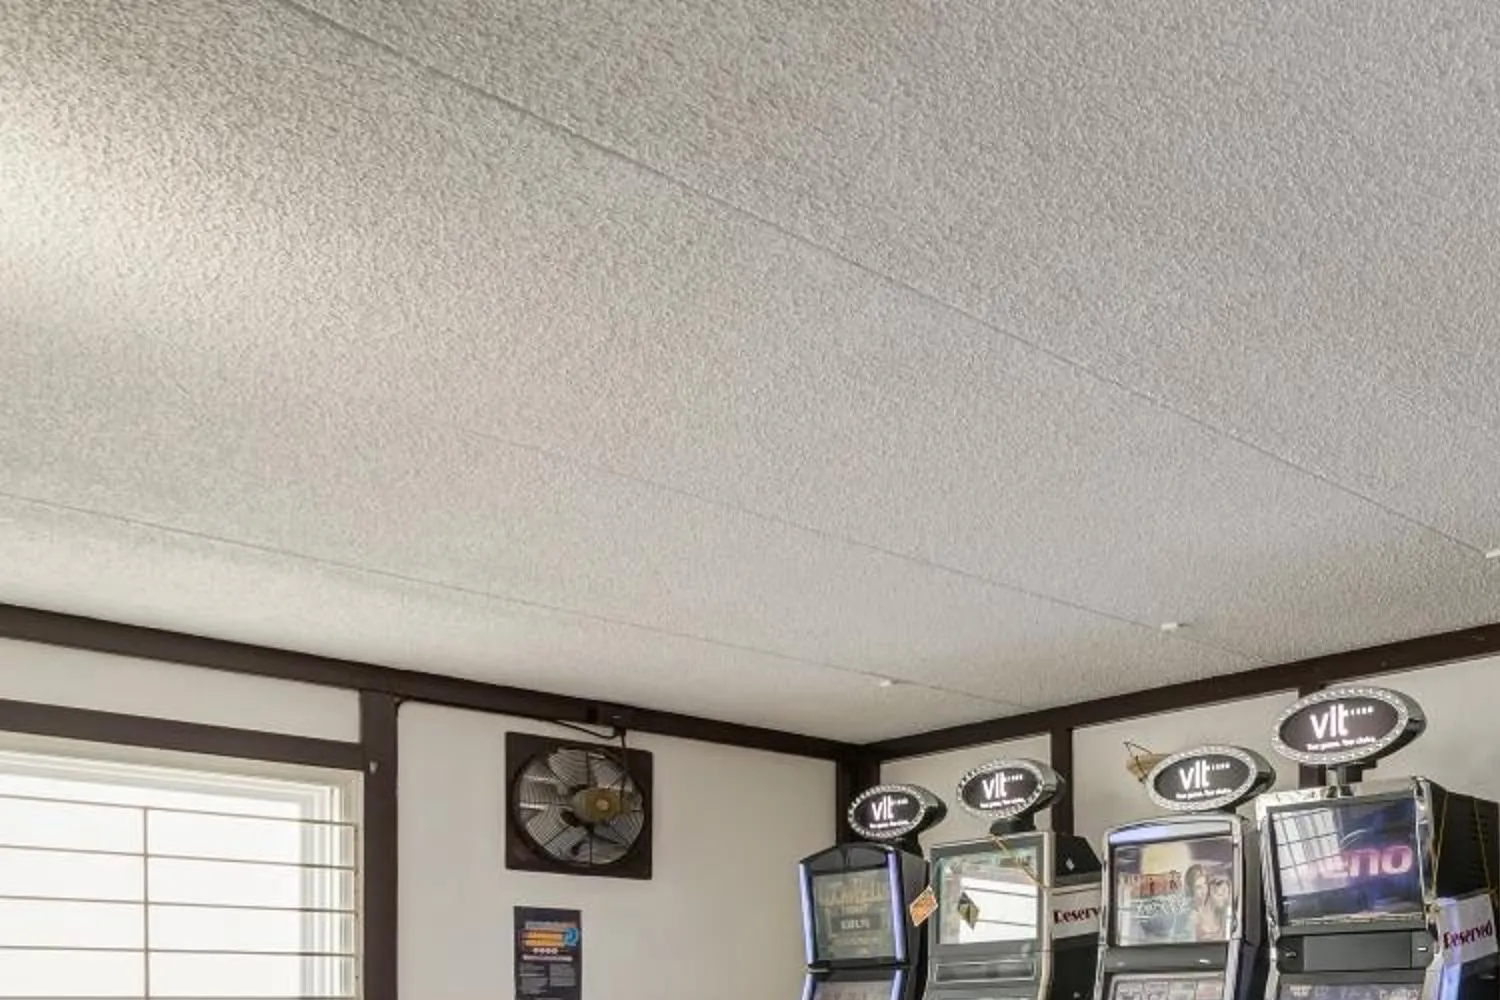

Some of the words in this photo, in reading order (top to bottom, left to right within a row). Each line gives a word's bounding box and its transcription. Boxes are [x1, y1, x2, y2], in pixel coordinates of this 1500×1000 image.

[1310, 704, 1349, 739] vlt
[982, 772, 1007, 800] vlt
[1179, 760, 1210, 791] vlt
[871, 796, 894, 821] vlt
[1053, 907, 1099, 925] Reserv
